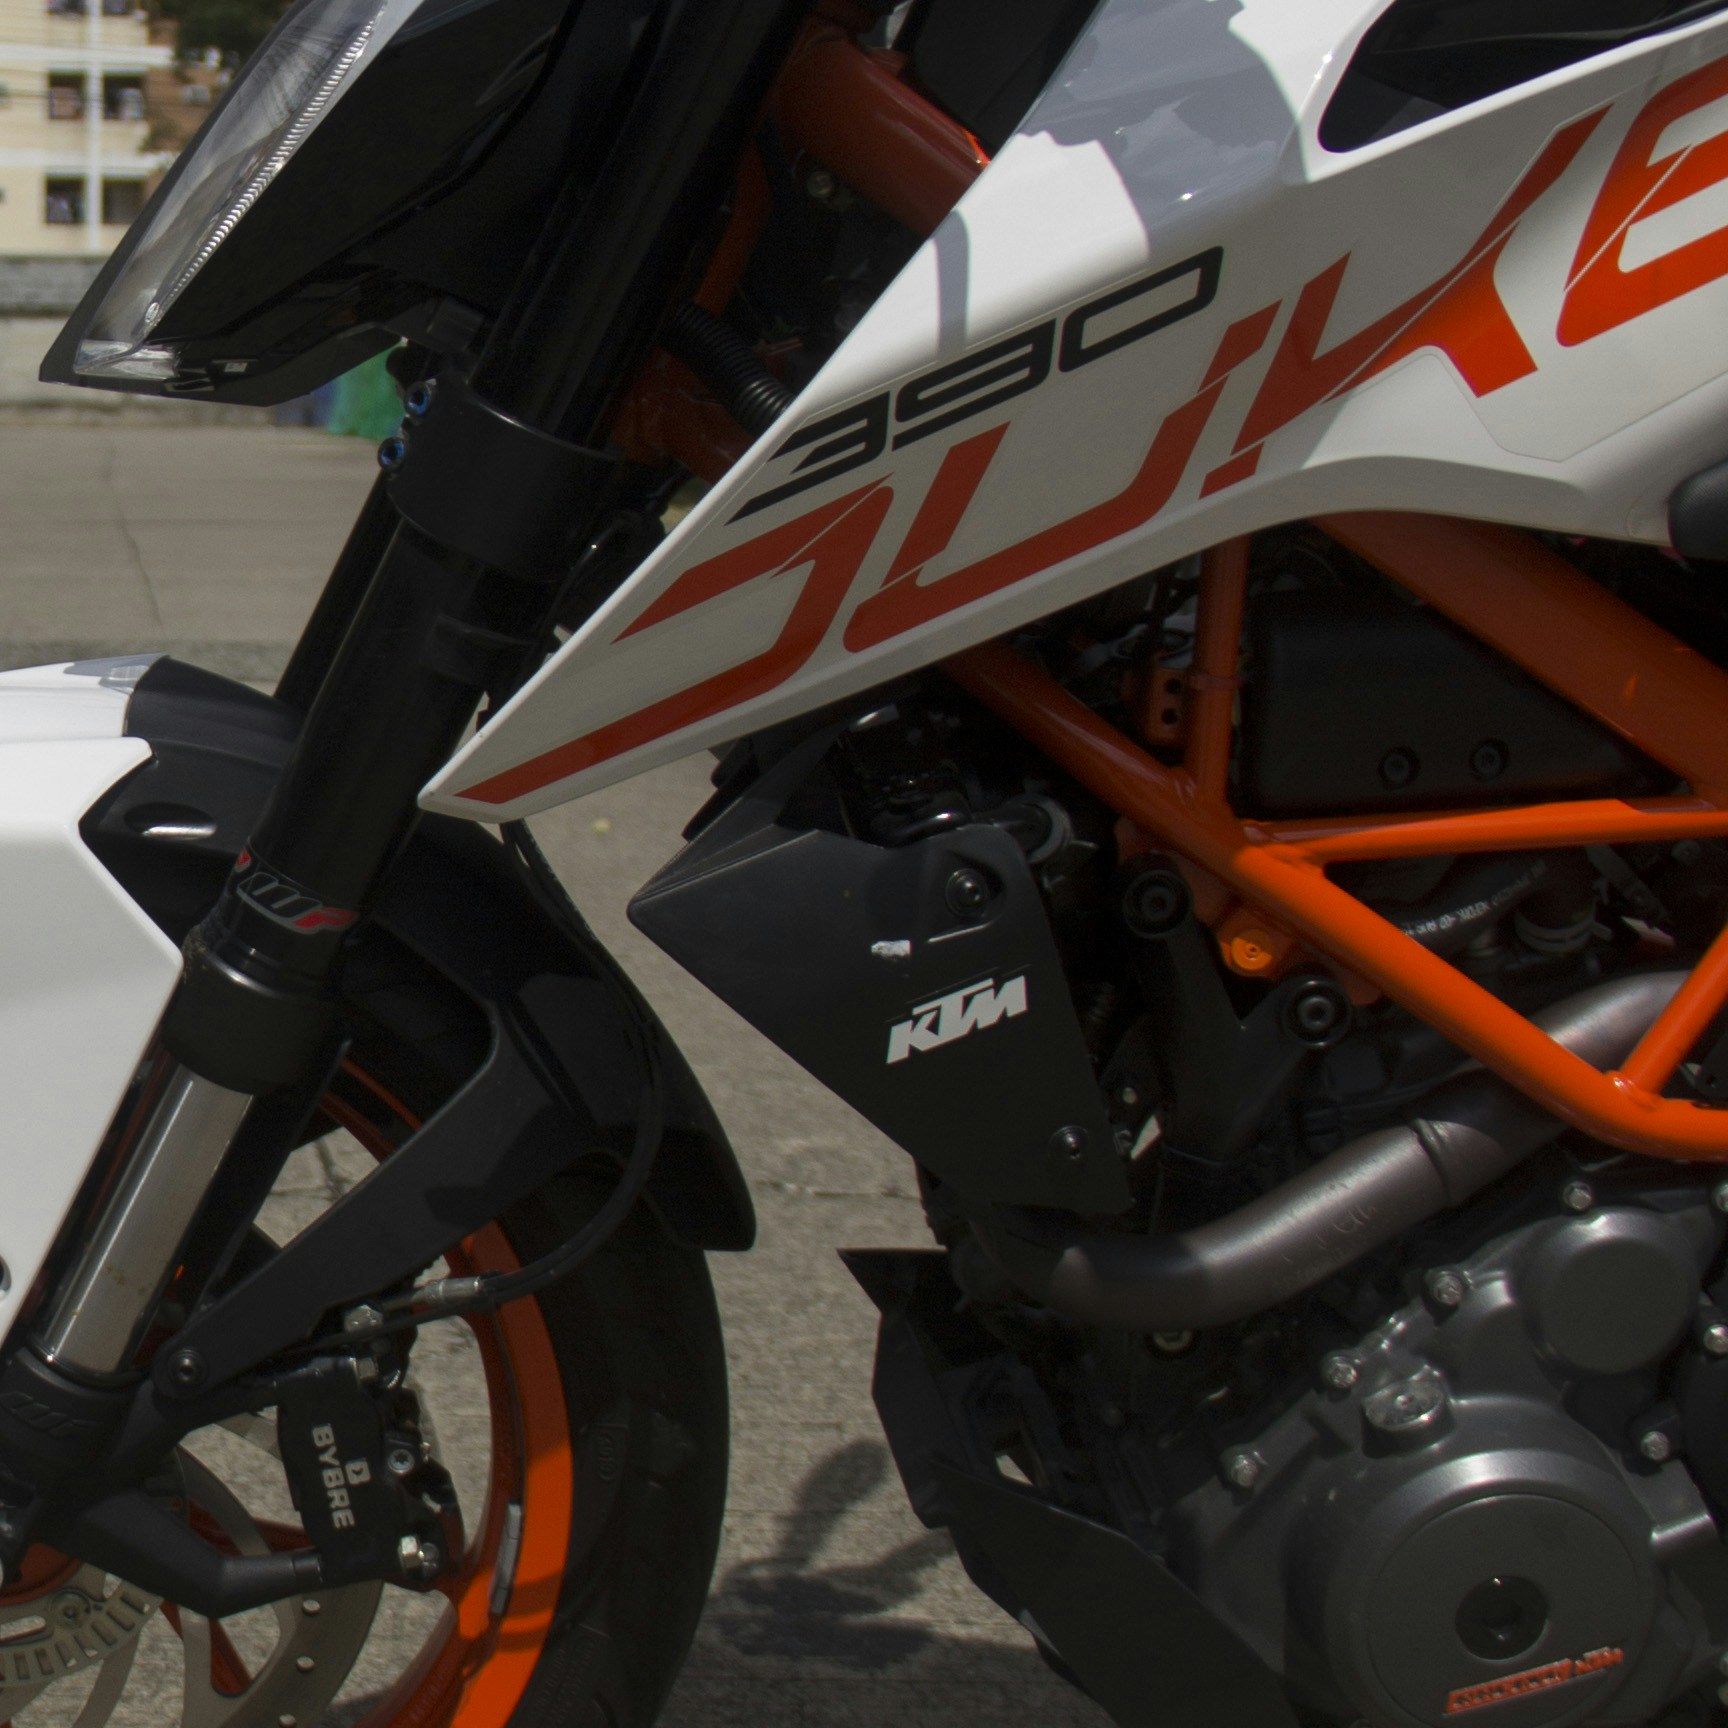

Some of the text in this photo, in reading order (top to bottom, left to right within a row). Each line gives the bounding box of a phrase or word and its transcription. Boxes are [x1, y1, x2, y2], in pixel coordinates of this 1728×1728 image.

[726, 245, 1223, 525] 390
[886, 974, 1029, 1064] KTM
[311, 1422, 356, 1530] BYBRE
